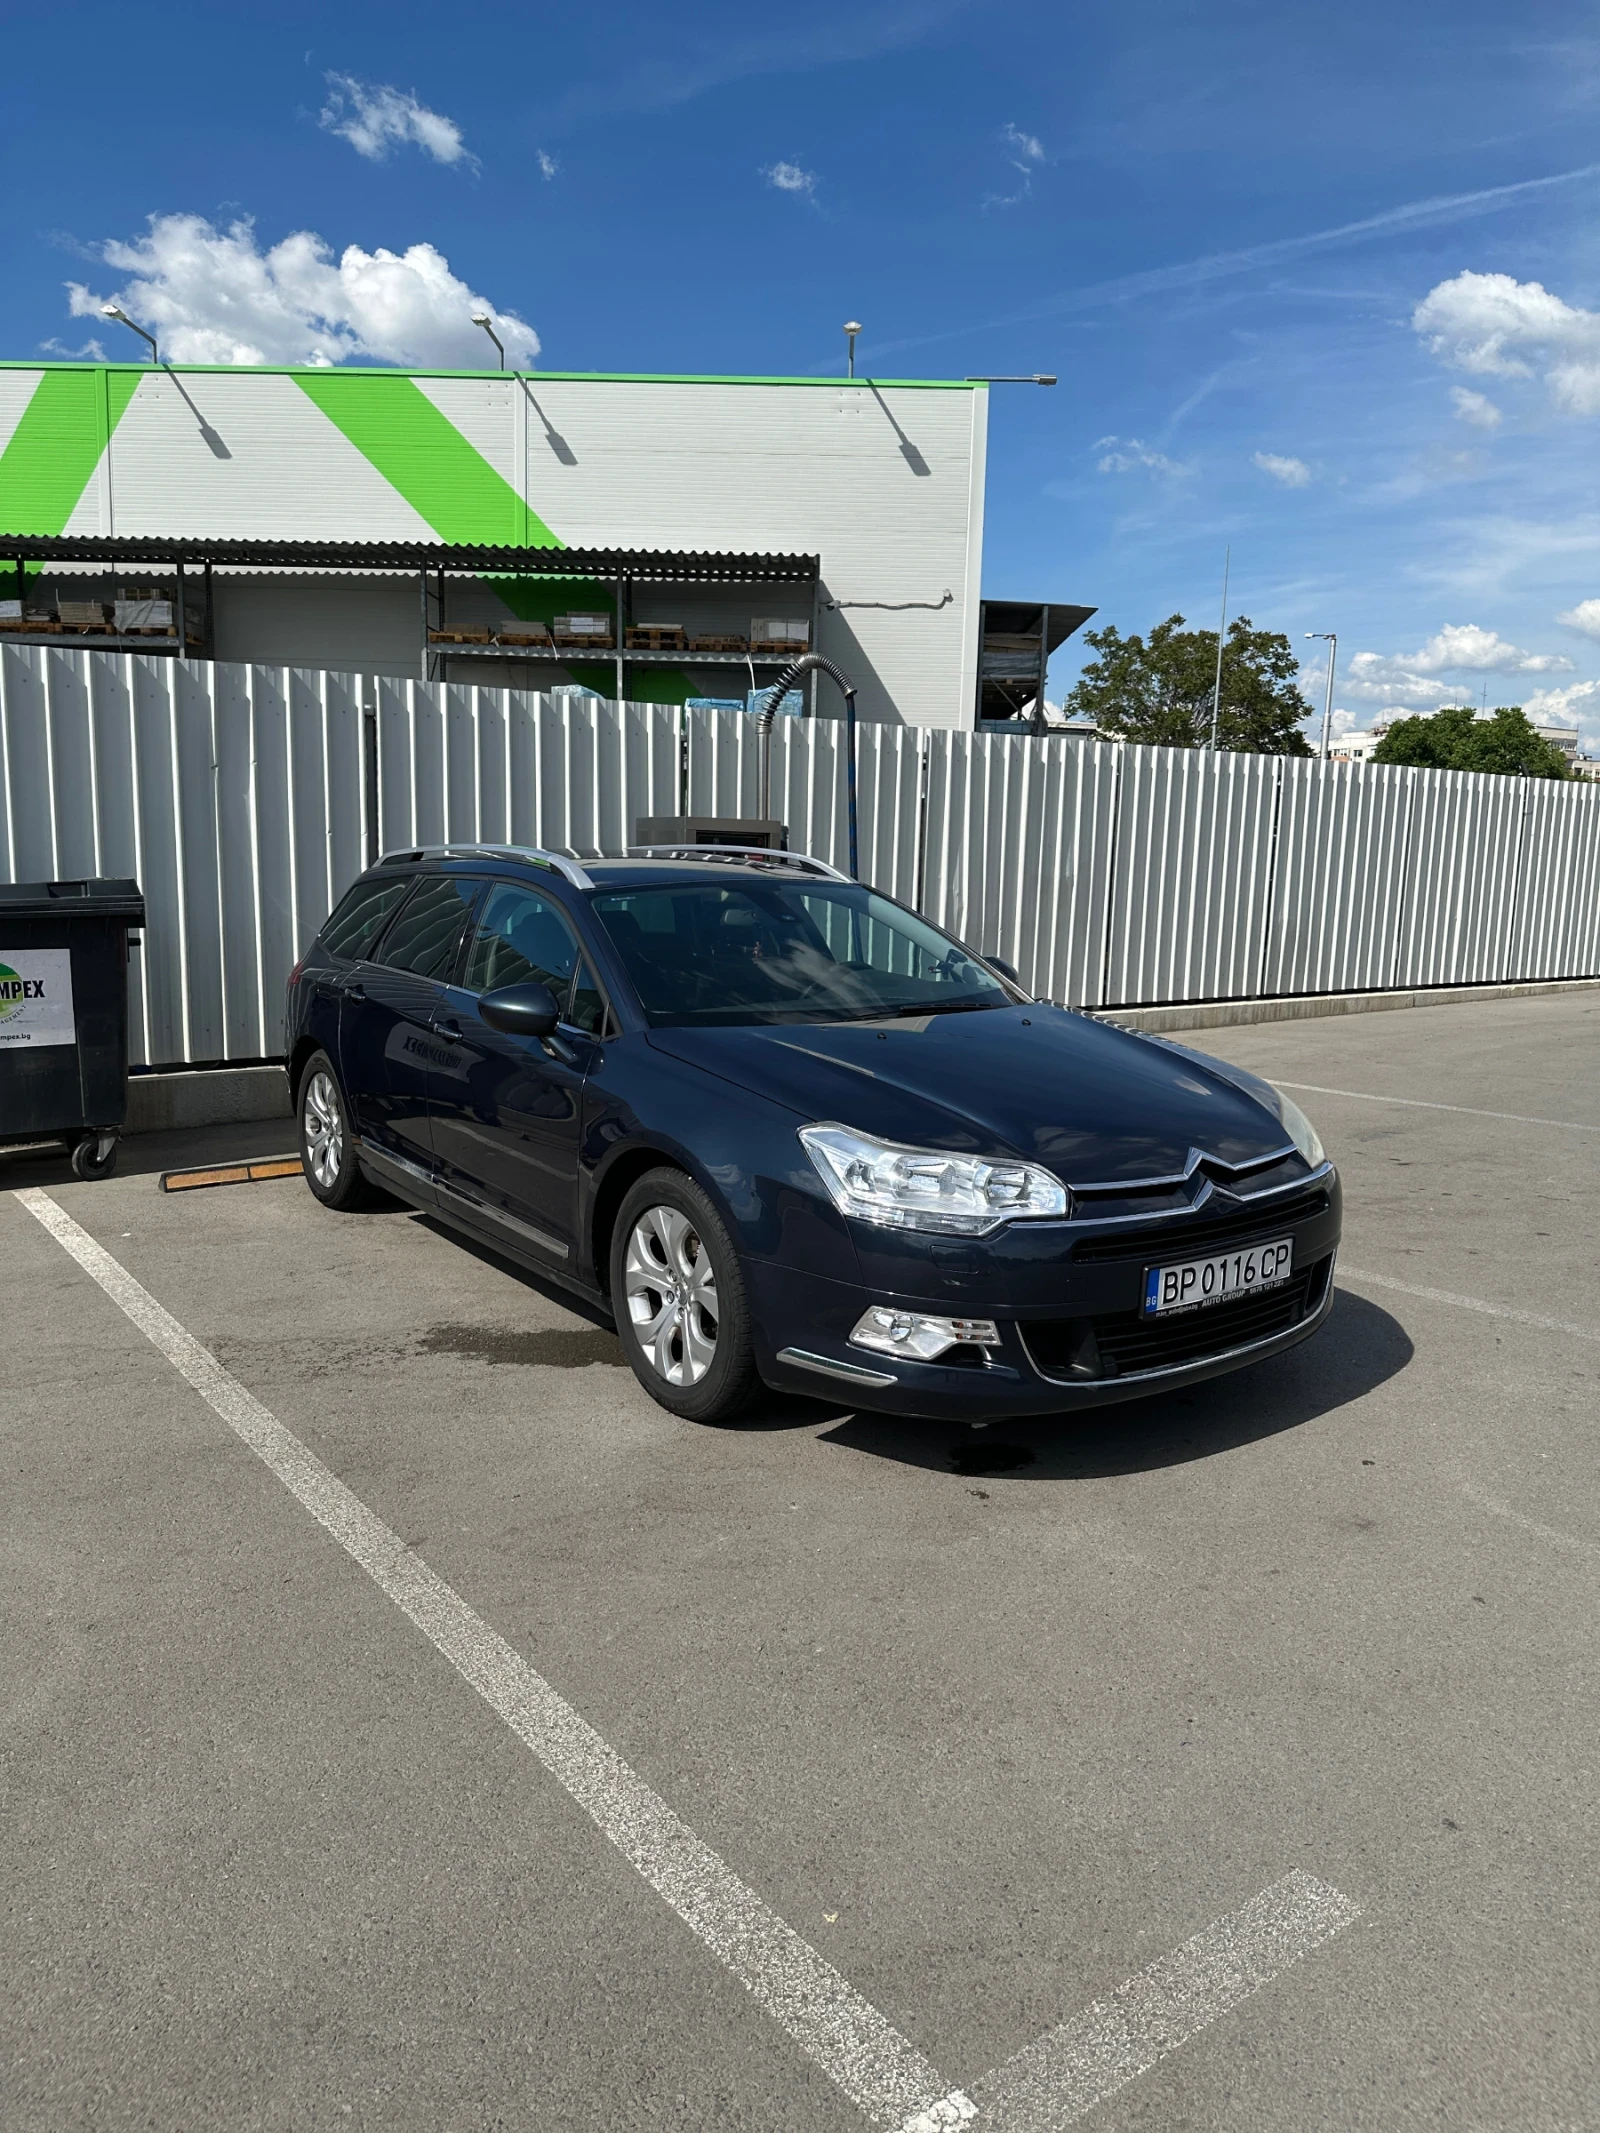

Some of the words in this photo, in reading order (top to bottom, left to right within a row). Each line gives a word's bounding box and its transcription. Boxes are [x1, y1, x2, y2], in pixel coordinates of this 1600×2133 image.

[1145, 1295, 1157, 1307] BG
[1201, 1296, 1221, 1308] AUTO
[1222, 1289, 1246, 1302] GROUP
